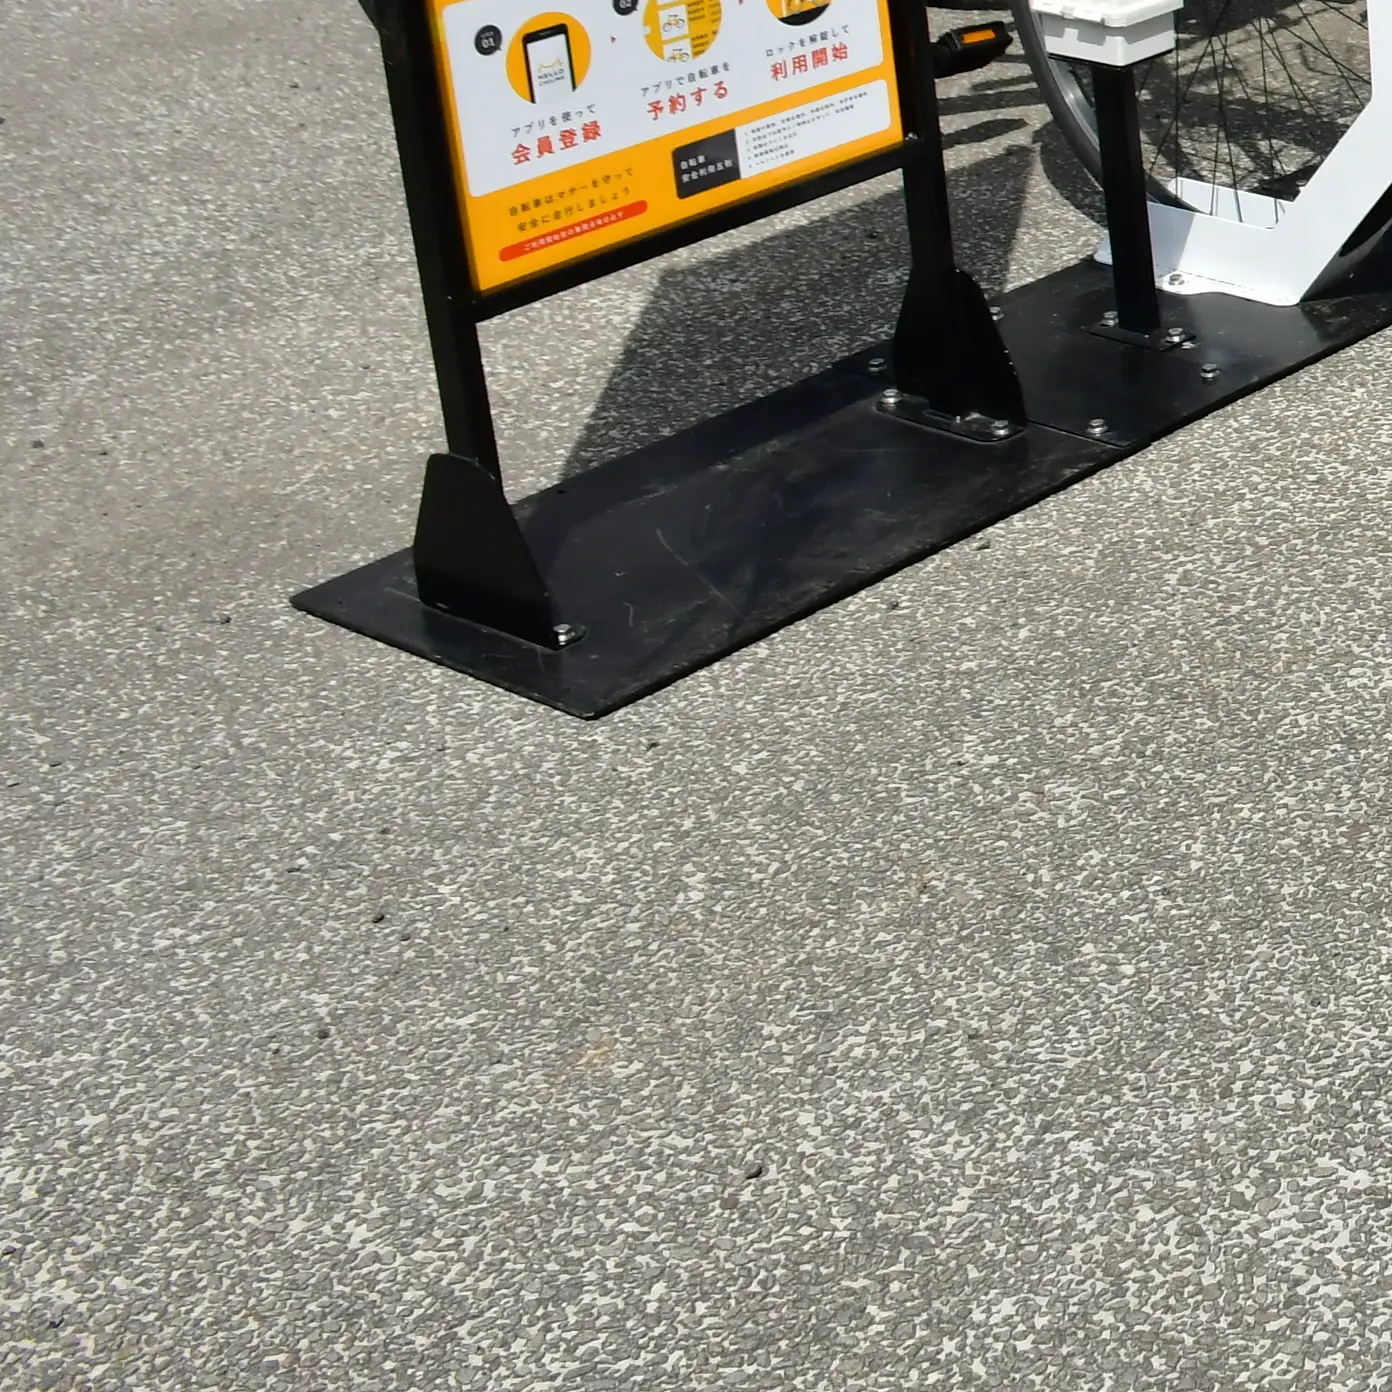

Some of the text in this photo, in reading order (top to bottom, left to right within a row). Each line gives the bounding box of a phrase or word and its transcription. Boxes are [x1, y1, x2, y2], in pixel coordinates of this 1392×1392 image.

[481, 37, 495, 49] 01
[765, 24, 850, 57] ロックを解錠して
[640, 61, 731, 98] アプリで自転車を
[770, 42, 849, 82] 利用開始
[647, 80, 728, 121] 予約する
[511, 104, 596, 138] アプリを使って
[511, 120, 602, 165] 会員登録
[509, 167, 633, 217] 自転車はマナーを守って
